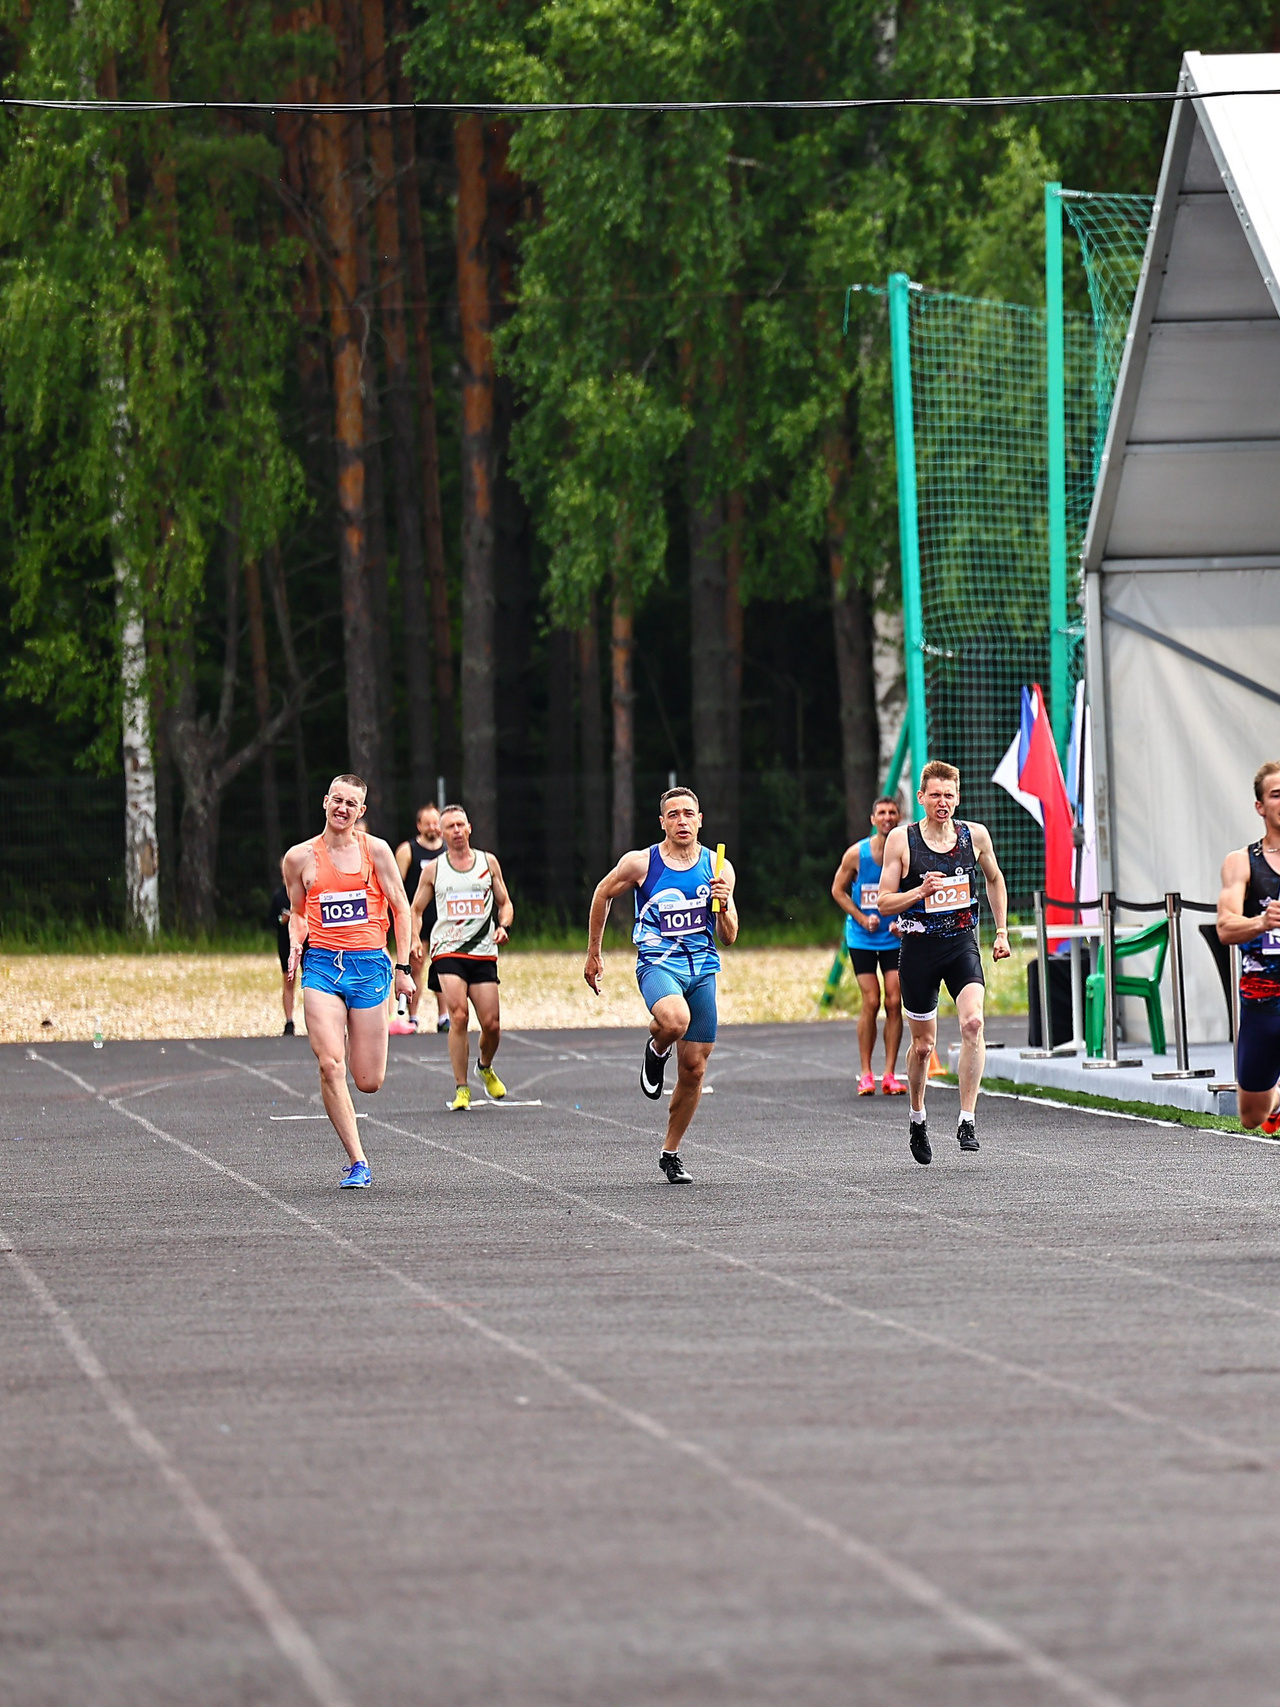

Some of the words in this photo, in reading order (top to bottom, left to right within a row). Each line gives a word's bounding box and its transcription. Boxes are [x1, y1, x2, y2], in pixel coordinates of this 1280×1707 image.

[863, 892, 879, 904] 10
[959, 890, 967, 901] 3
[322, 903, 354, 920] 103
[356, 906, 365, 917] 4
[450, 901, 472, 915] 101
[474, 904, 481, 914] 3
[664, 912, 692, 929] 101
[694, 915, 702, 925] 4
